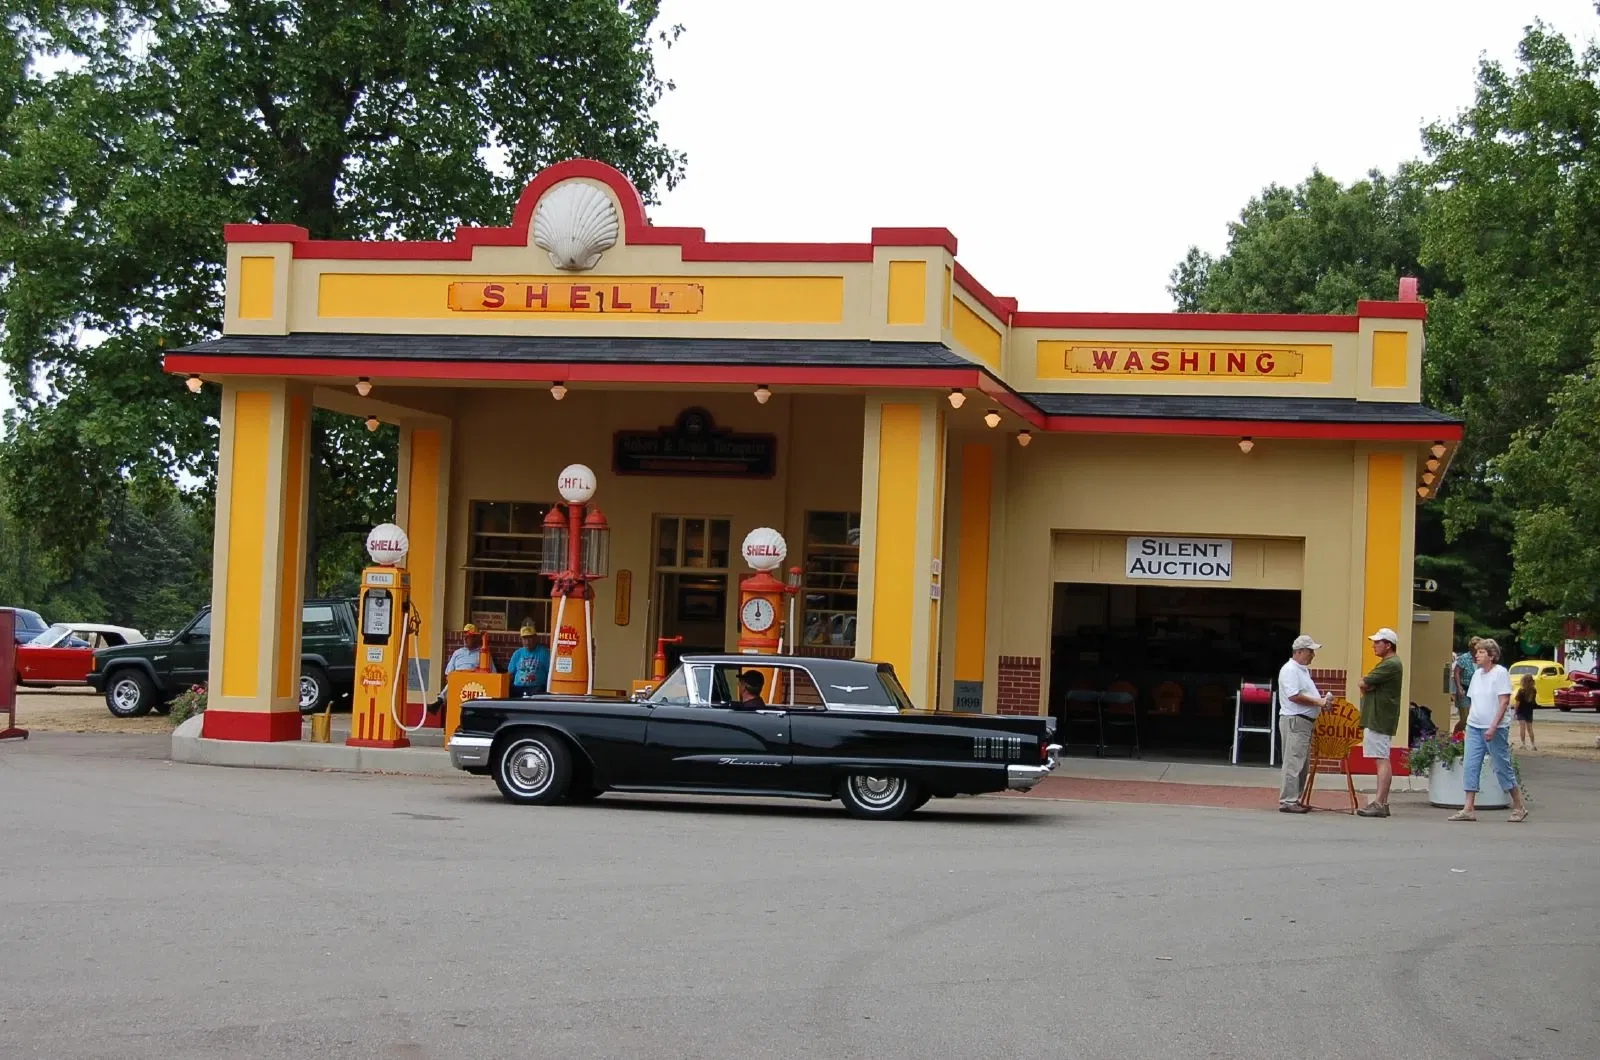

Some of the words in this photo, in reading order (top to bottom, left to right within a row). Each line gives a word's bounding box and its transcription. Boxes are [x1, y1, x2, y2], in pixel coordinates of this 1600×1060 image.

[481, 284, 670, 310] SHELL
[1092, 350, 1275, 374] WASHING
[370, 540, 402, 551] SHELL
[746, 544, 780, 556] SHELL
[1141, 539, 1223, 557] SILENT
[1129, 557, 1231, 577] AUCTION
[559, 632, 577, 641] HELL
[956, 697, 980, 711] 1999
[1315, 724, 1363, 740] SOLINE
